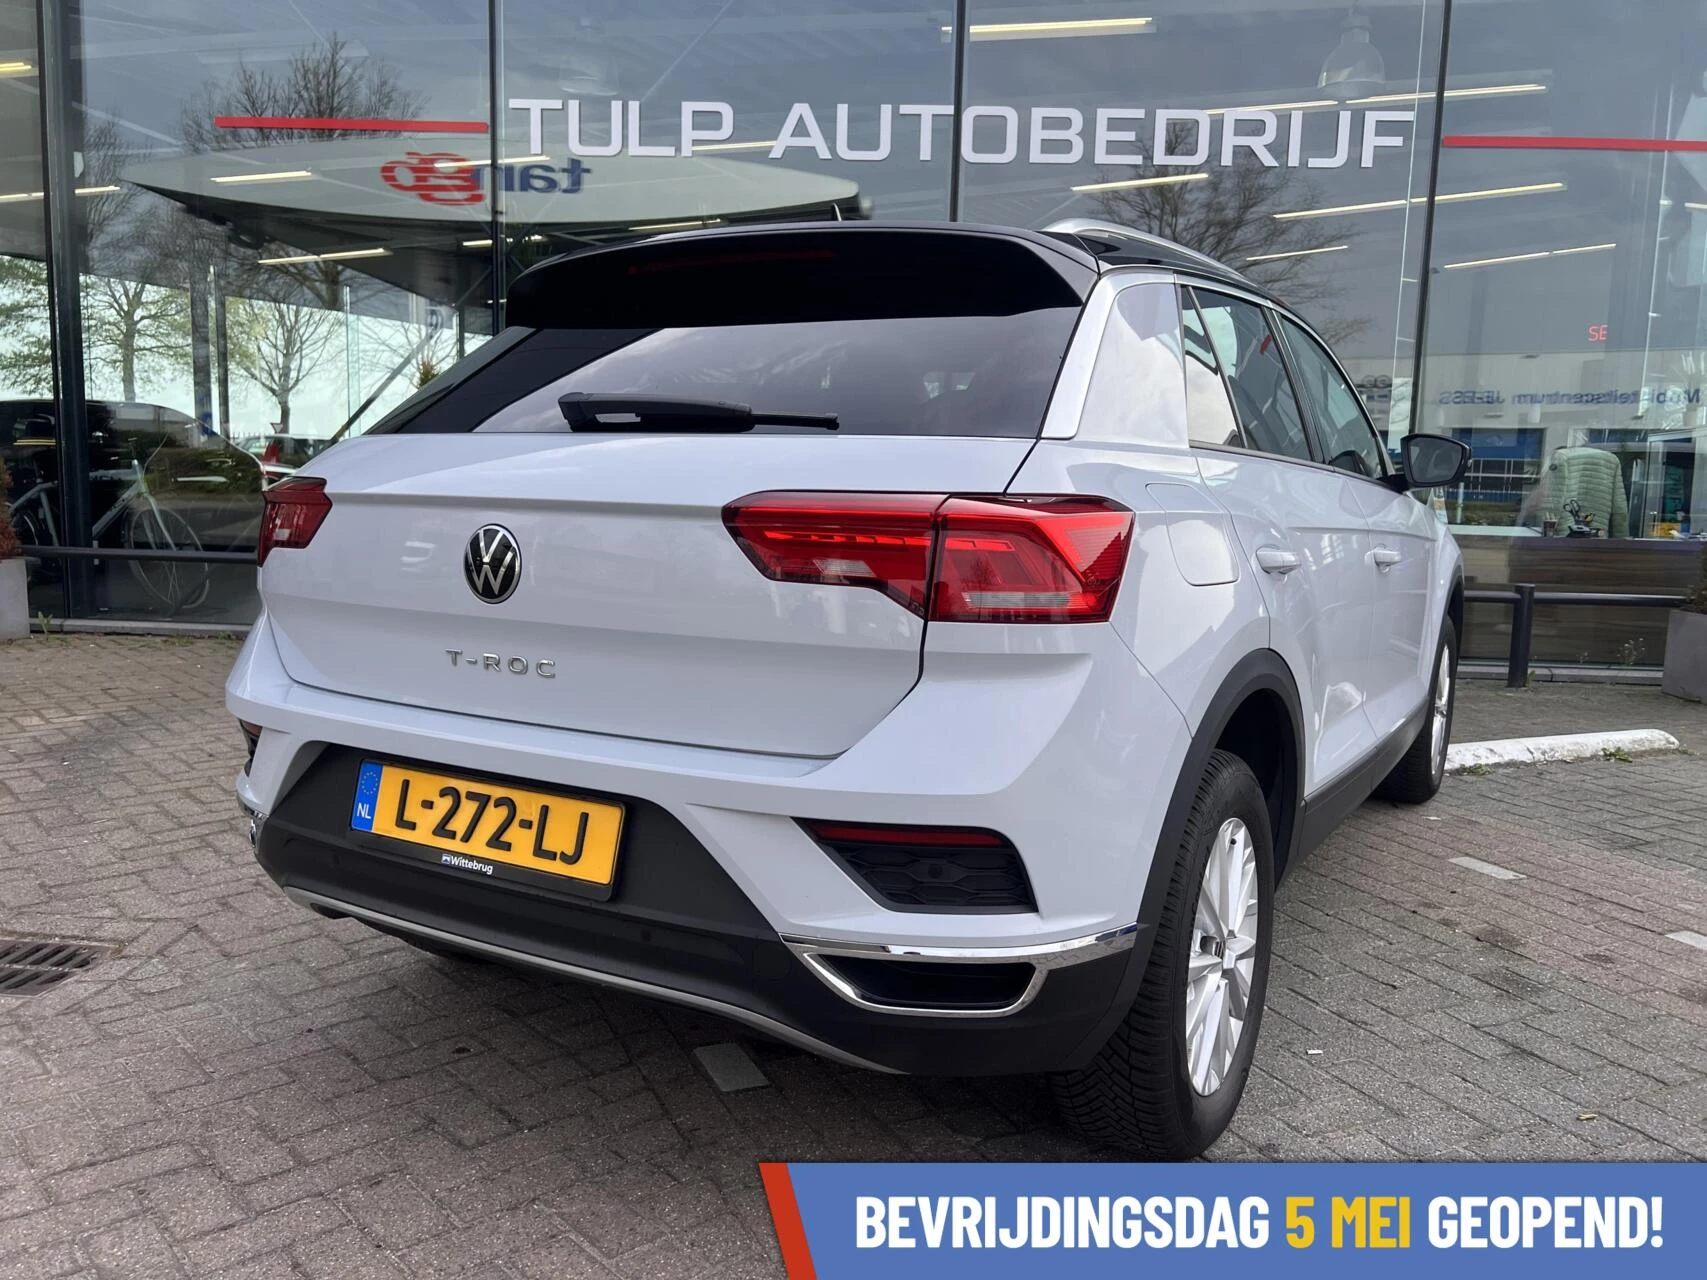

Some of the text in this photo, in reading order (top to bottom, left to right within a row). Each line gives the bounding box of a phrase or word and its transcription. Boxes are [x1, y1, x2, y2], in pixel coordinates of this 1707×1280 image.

[508, 98, 1415, 168] TULP AUTOBEDRIJF
[445, 648, 555, 678] T-ROC
[356, 802, 372, 819] NL
[395, 778, 589, 865] L-272-LJ
[451, 855, 493, 875] Wittebrug
